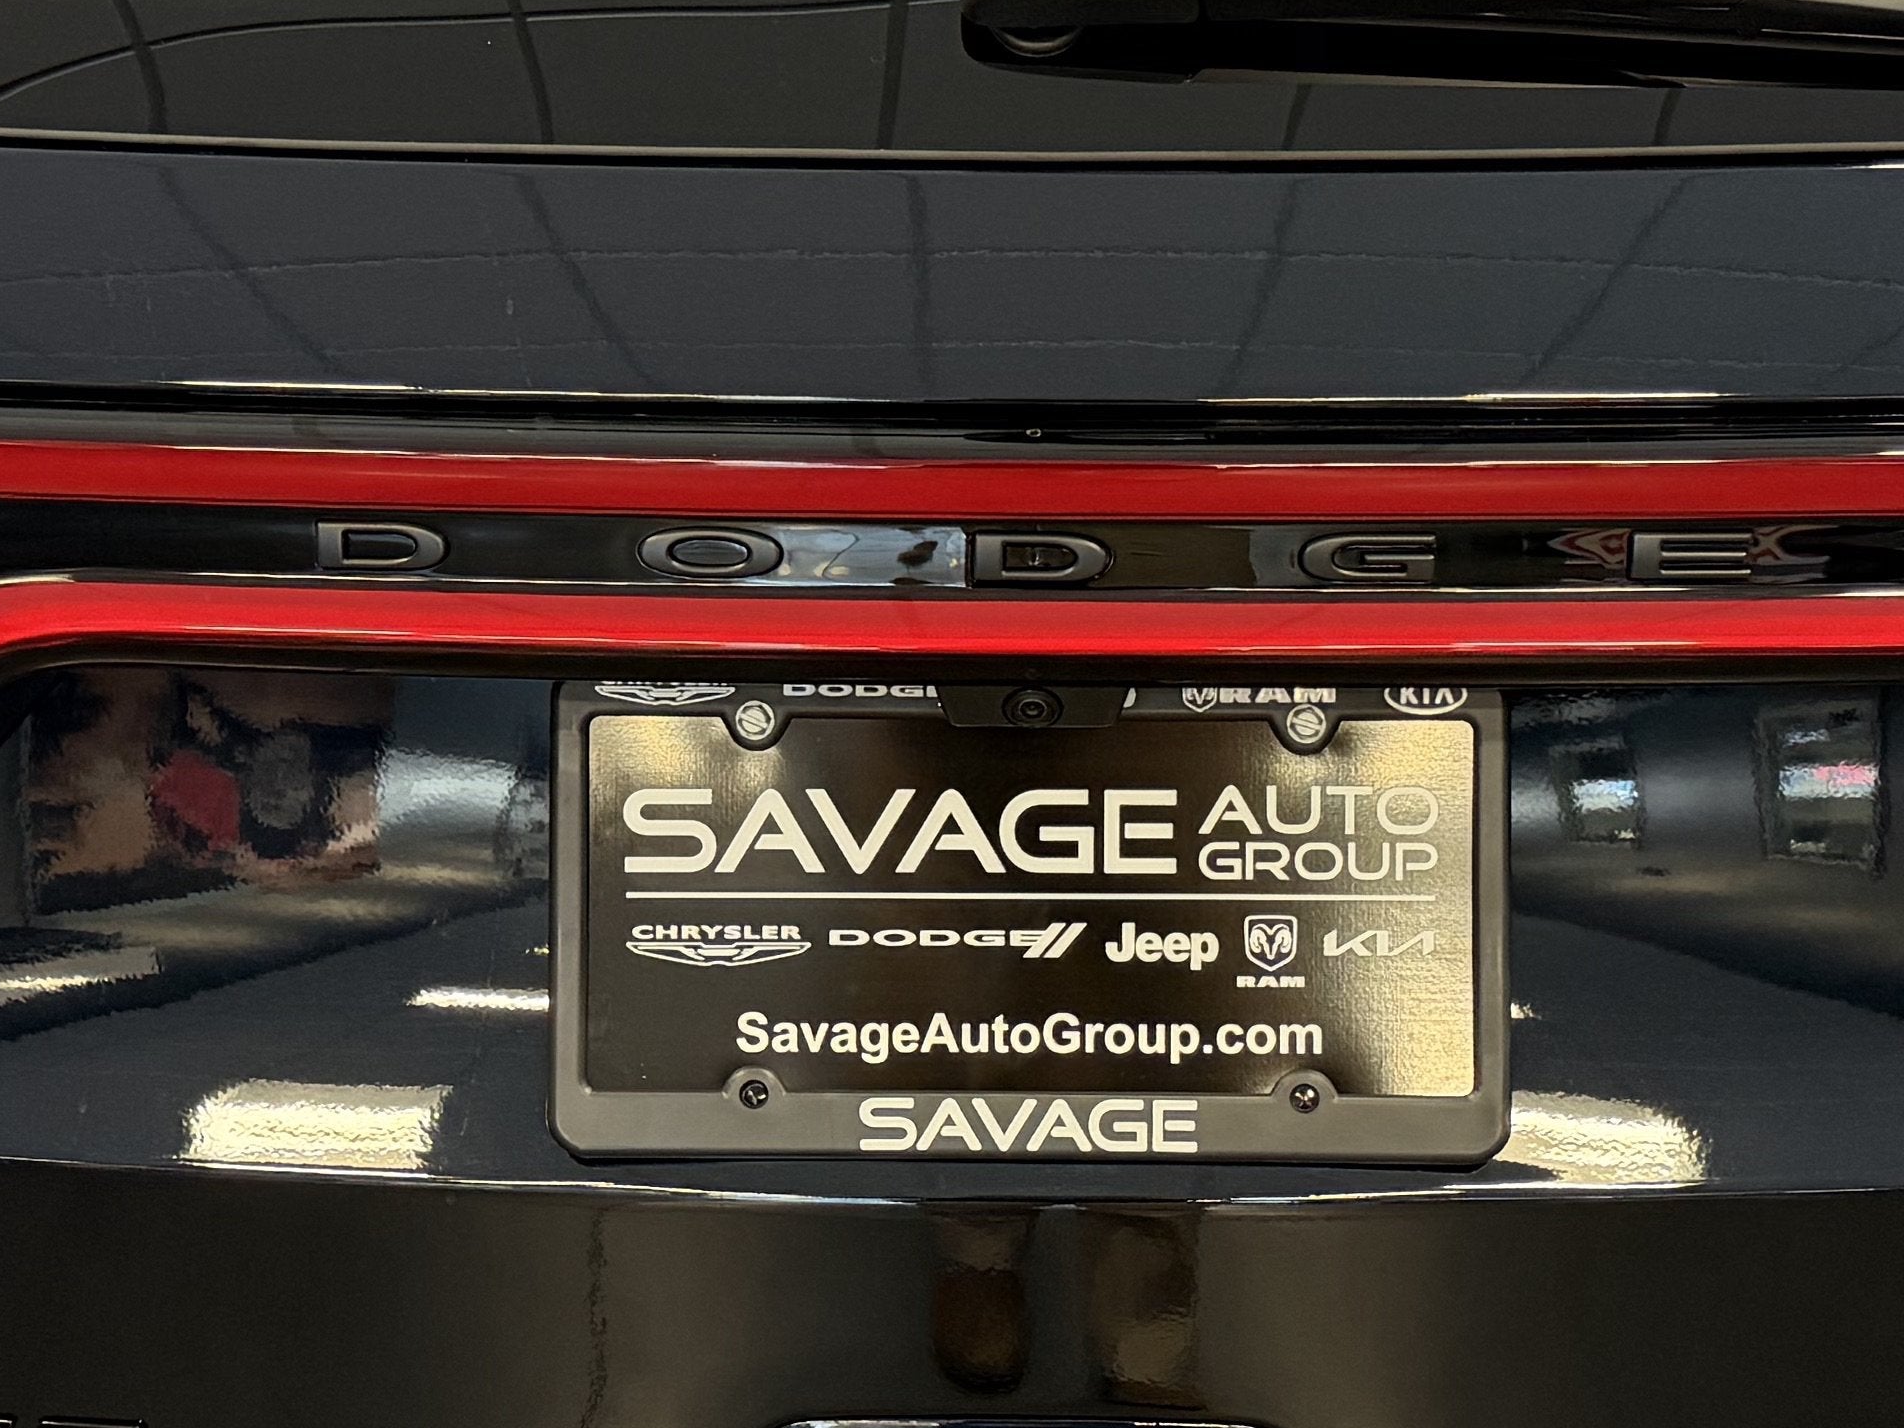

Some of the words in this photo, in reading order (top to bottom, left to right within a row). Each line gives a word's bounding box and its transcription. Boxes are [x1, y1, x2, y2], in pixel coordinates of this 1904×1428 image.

[315, 521, 1752, 582] DODGE
[1219, 686, 1337, 704] RAM
[624, 789, 1178, 875] SAVAGE
[1199, 785, 1441, 836] AUTO
[1198, 841, 1440, 882] GROUP
[631, 925, 802, 940] CHRYSLER
[828, 929, 1042, 947] DODGE
[1104, 922, 1220, 971] Jeep
[1236, 975, 1306, 988] RAM
[735, 1011, 1323, 1064] SavageAutoGroup.com
[859, 1097, 1199, 1154] SAVAGE
